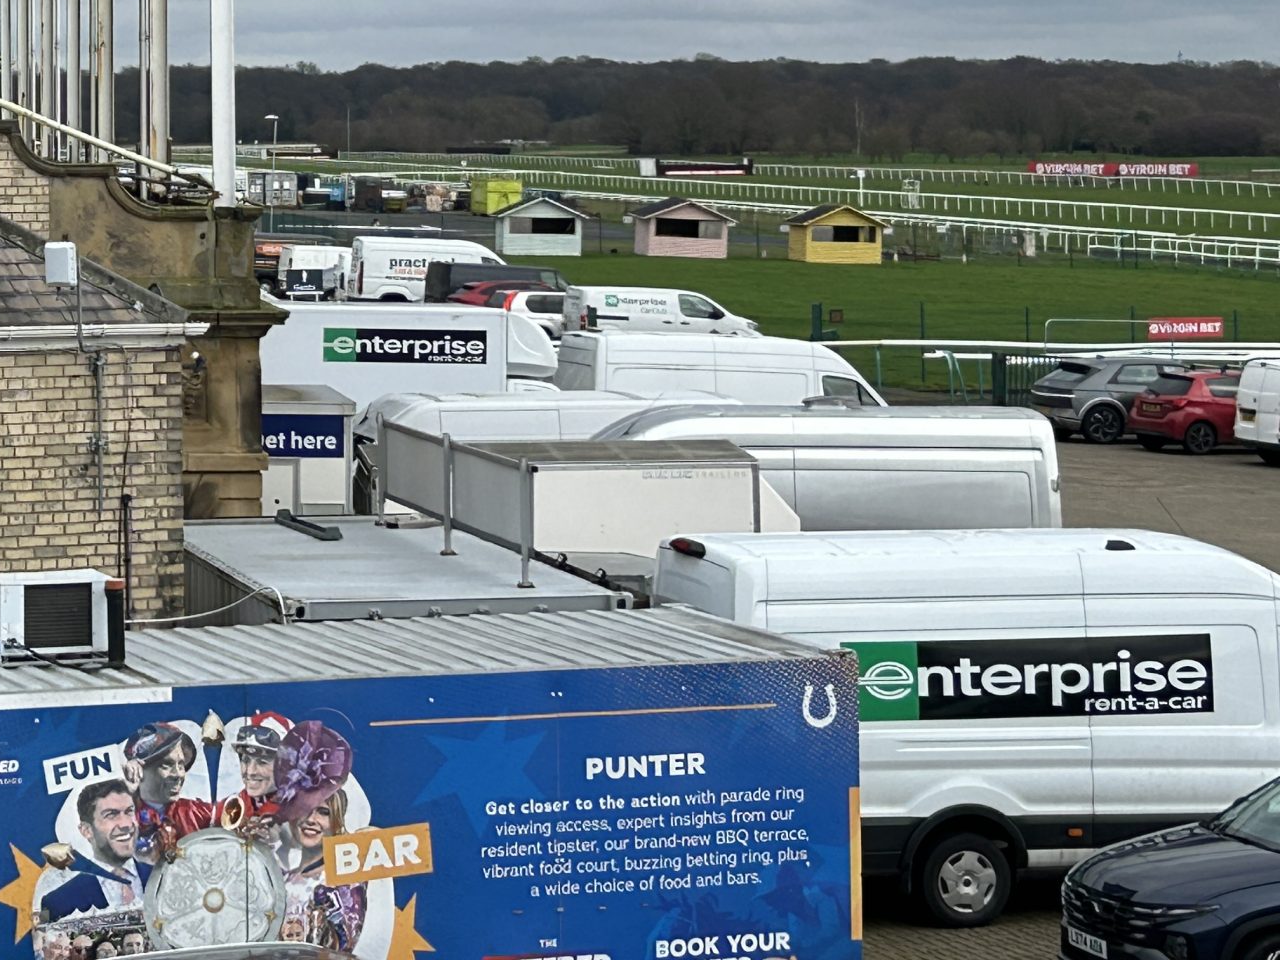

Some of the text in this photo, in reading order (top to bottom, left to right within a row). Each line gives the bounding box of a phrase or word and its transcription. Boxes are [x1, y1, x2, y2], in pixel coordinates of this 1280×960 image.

[1169, 163, 1191, 175] BET
[1199, 322, 1222, 333] BET
[331, 335, 485, 359] enterprise
[261, 431, 337, 450] et here
[860, 649, 1208, 707] enterprise
[1085, 694, 1207, 712] rent-a-car
[52, 752, 113, 785] FUN
[586, 752, 706, 780] PUNTER
[485, 786, 805, 815] Get closer to the action with parade ring
[495, 808, 795, 837] viewing access, expert insights from our
[334, 833, 422, 875] BAR
[481, 828, 809, 858] resident tipster, our brand-new BBQ terrace,
[482, 863, 535, 879] vibrant
[539, 859, 572, 876] food
[576, 858, 620, 873] court,
[624, 854, 682, 872] buzzing
[686, 851, 738, 868] betting
[531, 871, 762, 897] a wide choice of food and bars.
[655, 931, 791, 958] BOOK YOUR
